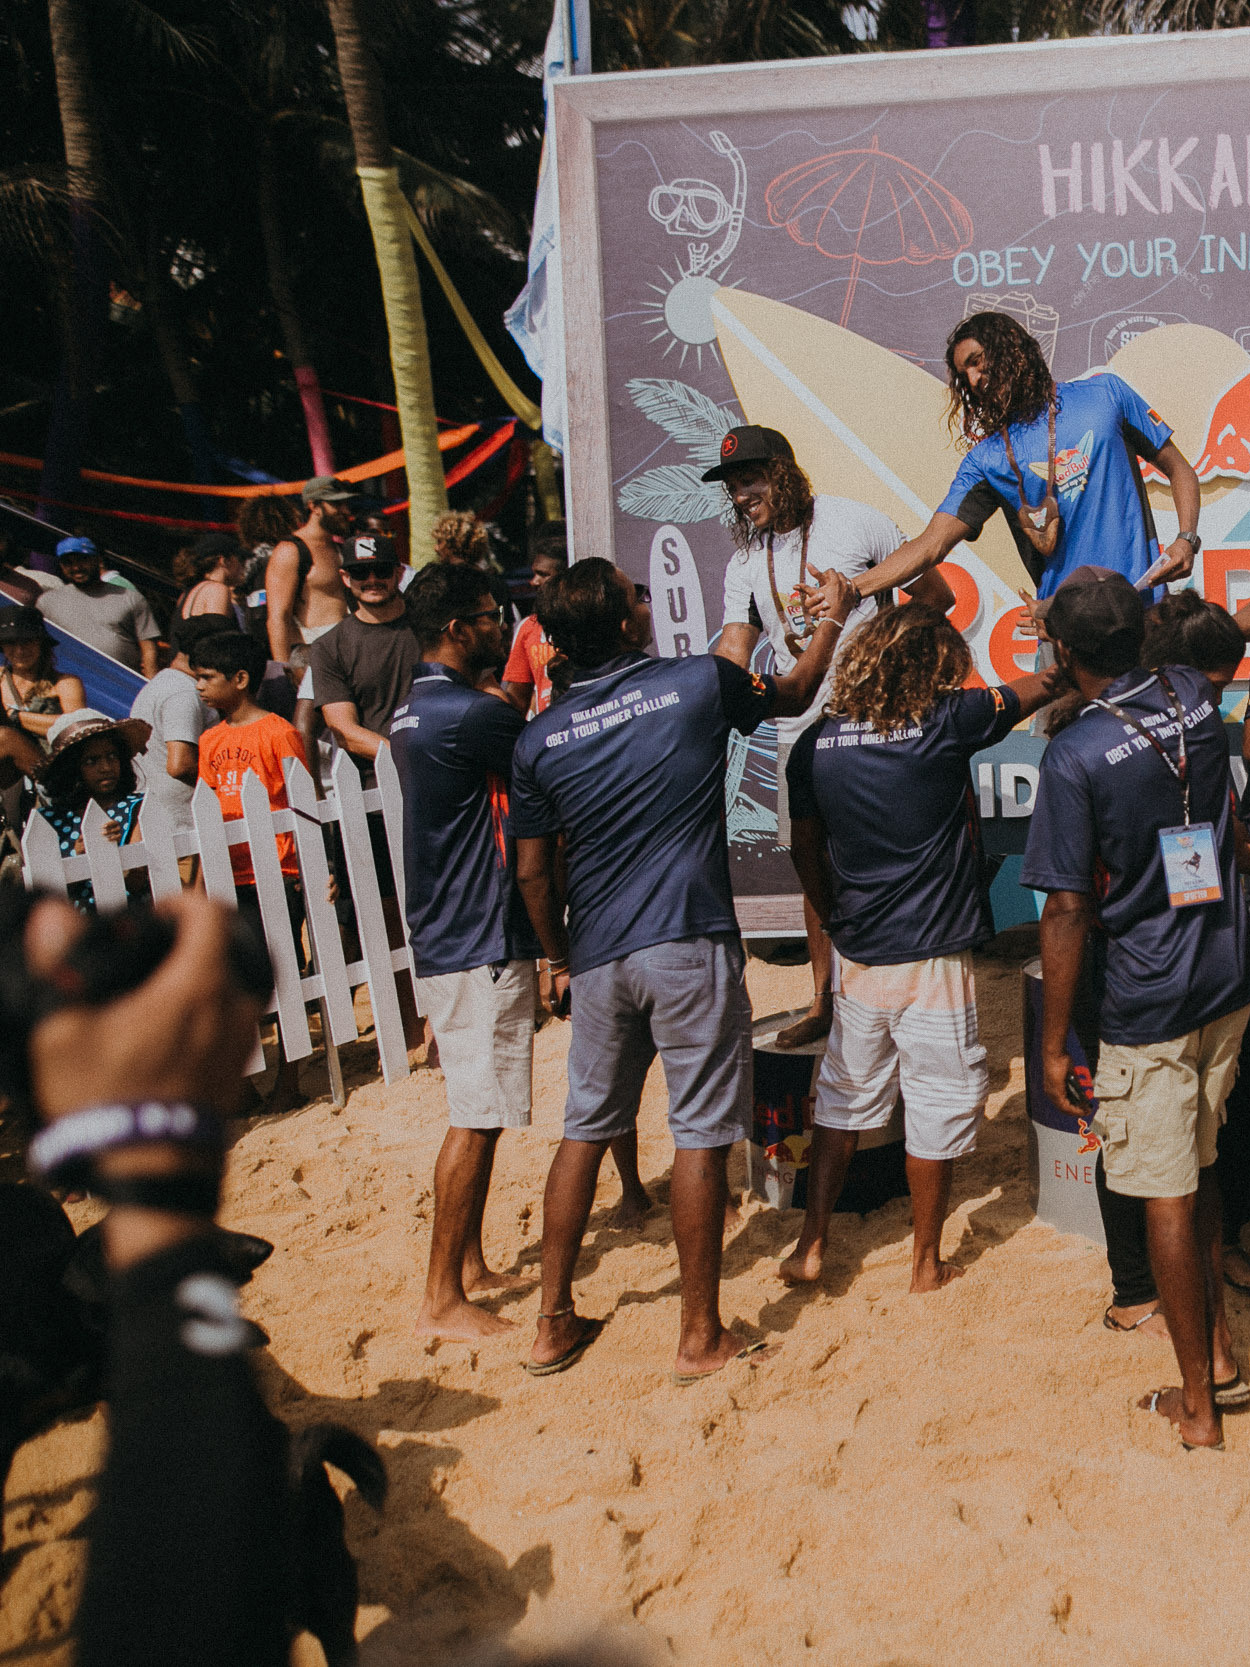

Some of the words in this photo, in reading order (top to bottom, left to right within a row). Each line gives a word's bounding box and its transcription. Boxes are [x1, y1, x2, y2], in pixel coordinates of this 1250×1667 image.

[952, 244, 1055, 288] OBEY
[1077, 237, 1179, 283] YOUR
[1070, 455, 1090, 474] Bull
[661, 537, 693, 658] SUR
[786, 605, 801, 616] Re
[545, 729, 569, 748] OBEY
[572, 721, 600, 739] YOUR
[602, 709, 632, 729] INNER
[634, 691, 681, 717] CALLING
[571, 699, 620, 724] HIKKADUWA
[816, 737, 836, 750] OBEY
[837, 734, 859, 747] YOUR
[888, 727, 923, 743] CALLING
[1104, 741, 1133, 765] OBEY
[978, 762, 1041, 819] ID
[1054, 1159, 1093, 1185] ENE
